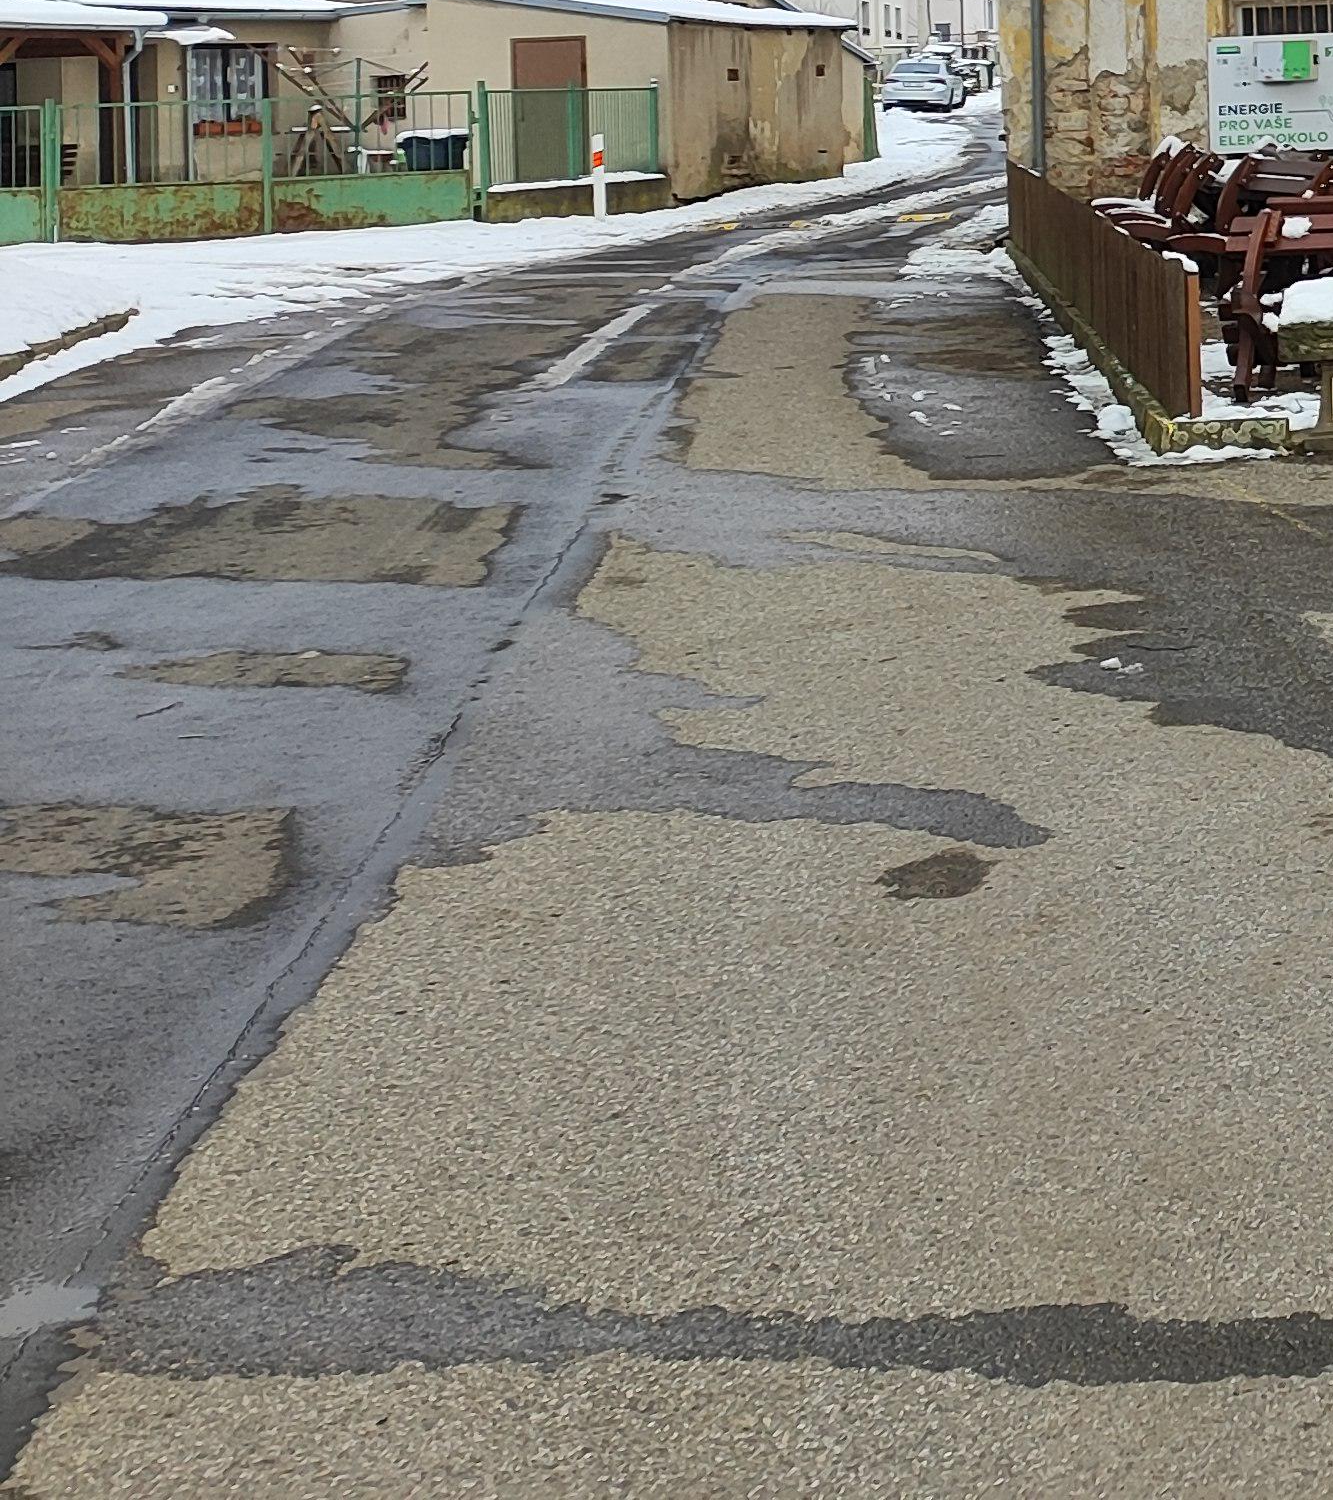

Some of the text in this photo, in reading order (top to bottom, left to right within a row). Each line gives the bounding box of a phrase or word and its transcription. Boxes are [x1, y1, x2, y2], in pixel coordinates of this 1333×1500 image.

[1218, 102, 1283, 116] ENERGIE
[1218, 115, 1292, 131] PRO VAŠE
